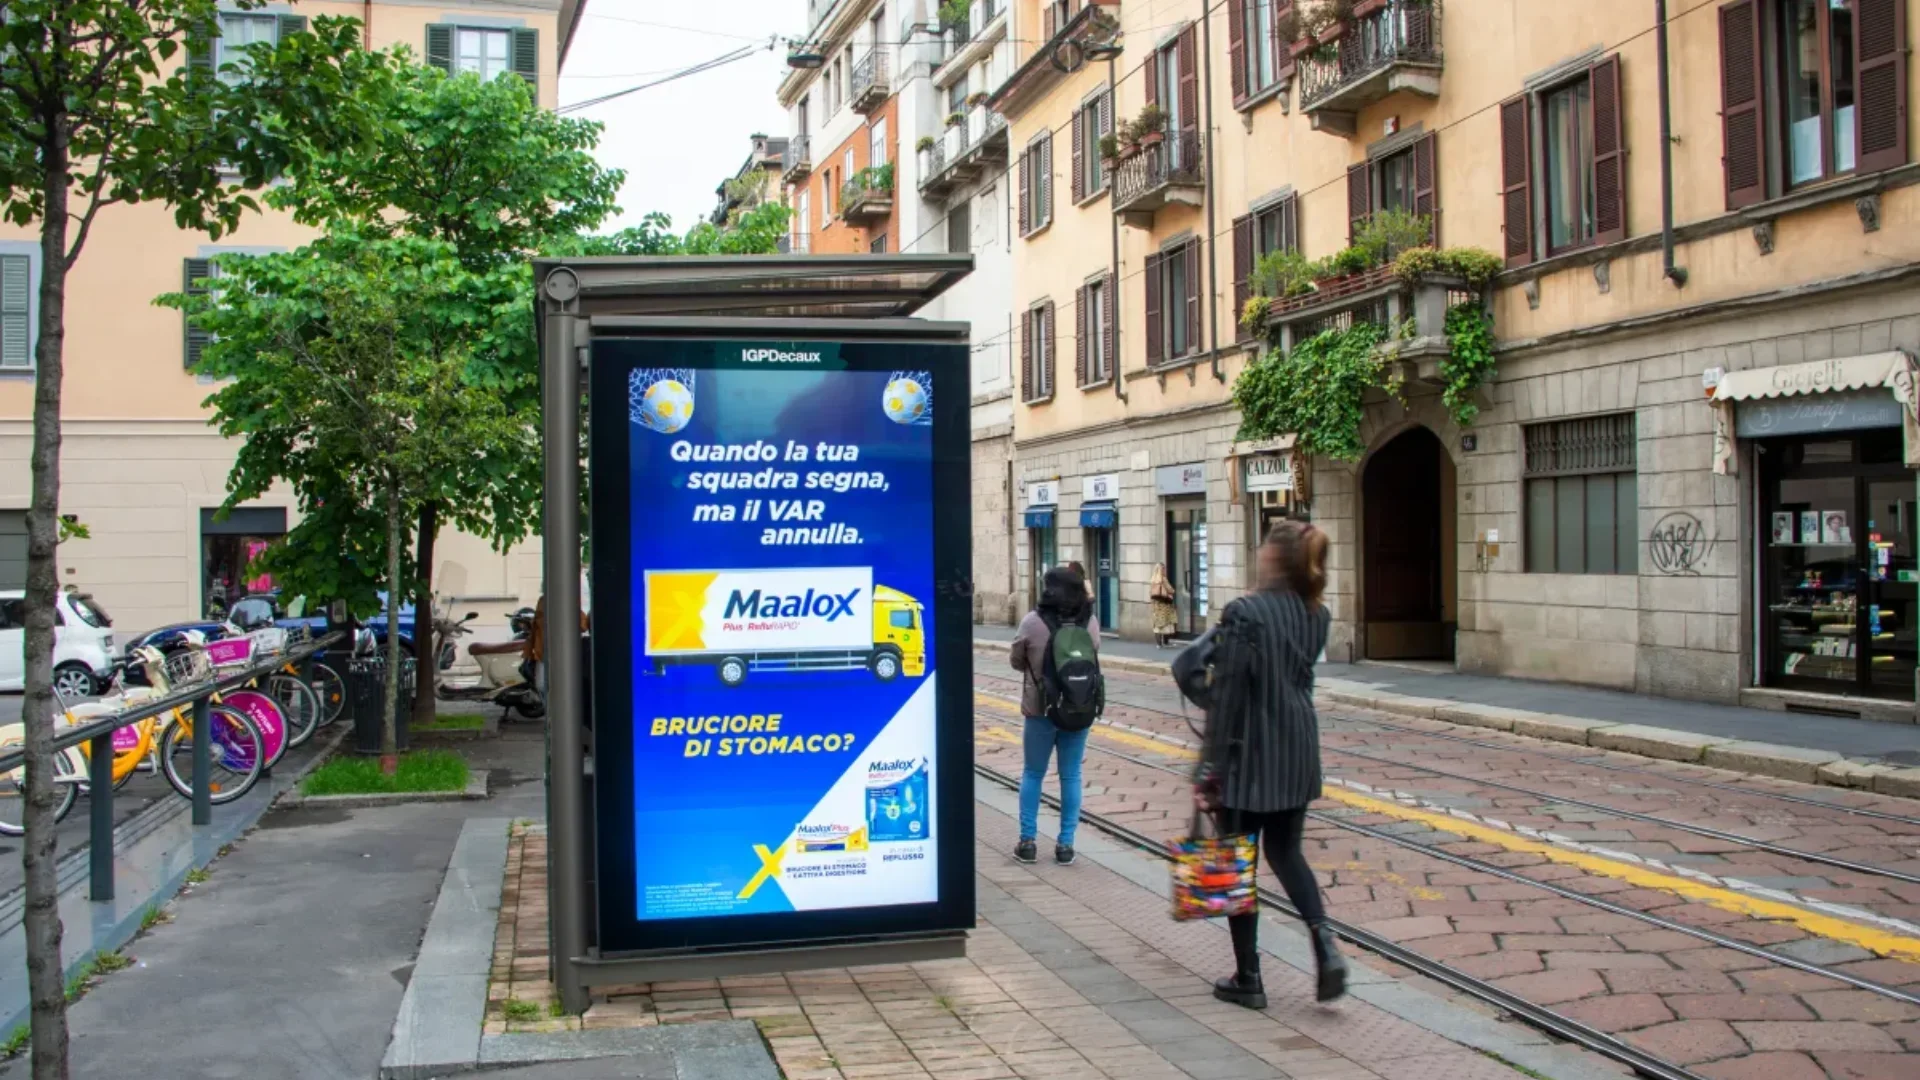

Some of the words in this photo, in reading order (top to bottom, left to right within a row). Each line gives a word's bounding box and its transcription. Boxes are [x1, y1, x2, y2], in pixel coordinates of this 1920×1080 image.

[741, 349, 821, 363] IGPDecaux
[670, 439, 778, 464] Quando
[784, 439, 808, 462] la
[815, 442, 859, 462] tua
[1247, 457, 1289, 477] CALZOL
[686, 467, 799, 494] squadra
[804, 470, 891, 494] segna,
[692, 502, 736, 523] ma
[742, 499, 760, 522] il
[768, 499, 825, 522] VAR
[760, 523, 865, 546] annulla.
[723, 587, 862, 622] Maalox
[722, 622, 744, 632] Plus
[649, 713, 783, 736] BRUCIORE
[683, 738, 711, 758] DI
[717, 733, 856, 757] STOMACO?
[868, 757, 916, 773] Maalox
[882, 852, 925, 862] REFLUSSO
